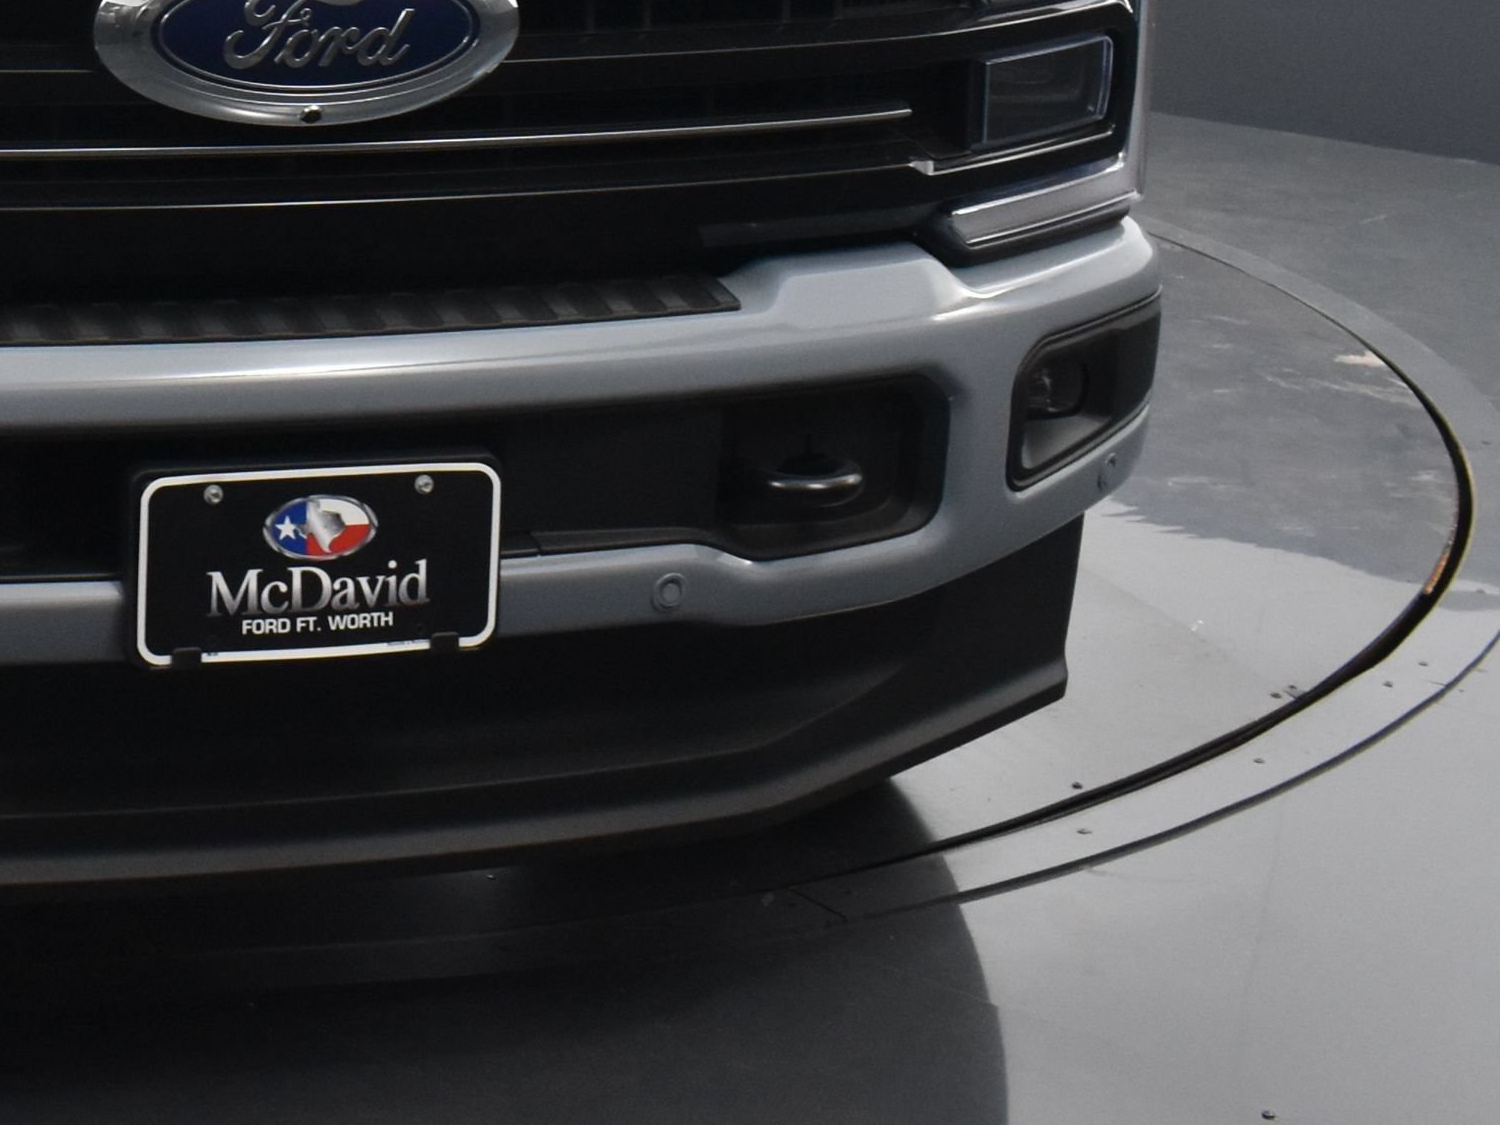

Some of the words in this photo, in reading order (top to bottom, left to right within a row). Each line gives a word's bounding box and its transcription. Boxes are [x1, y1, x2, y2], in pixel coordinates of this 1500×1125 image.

[206, 558, 432, 617] McDavid
[241, 618, 292, 636] FORD
[296, 617, 322, 633] FT.
[327, 611, 395, 631] WORTH
